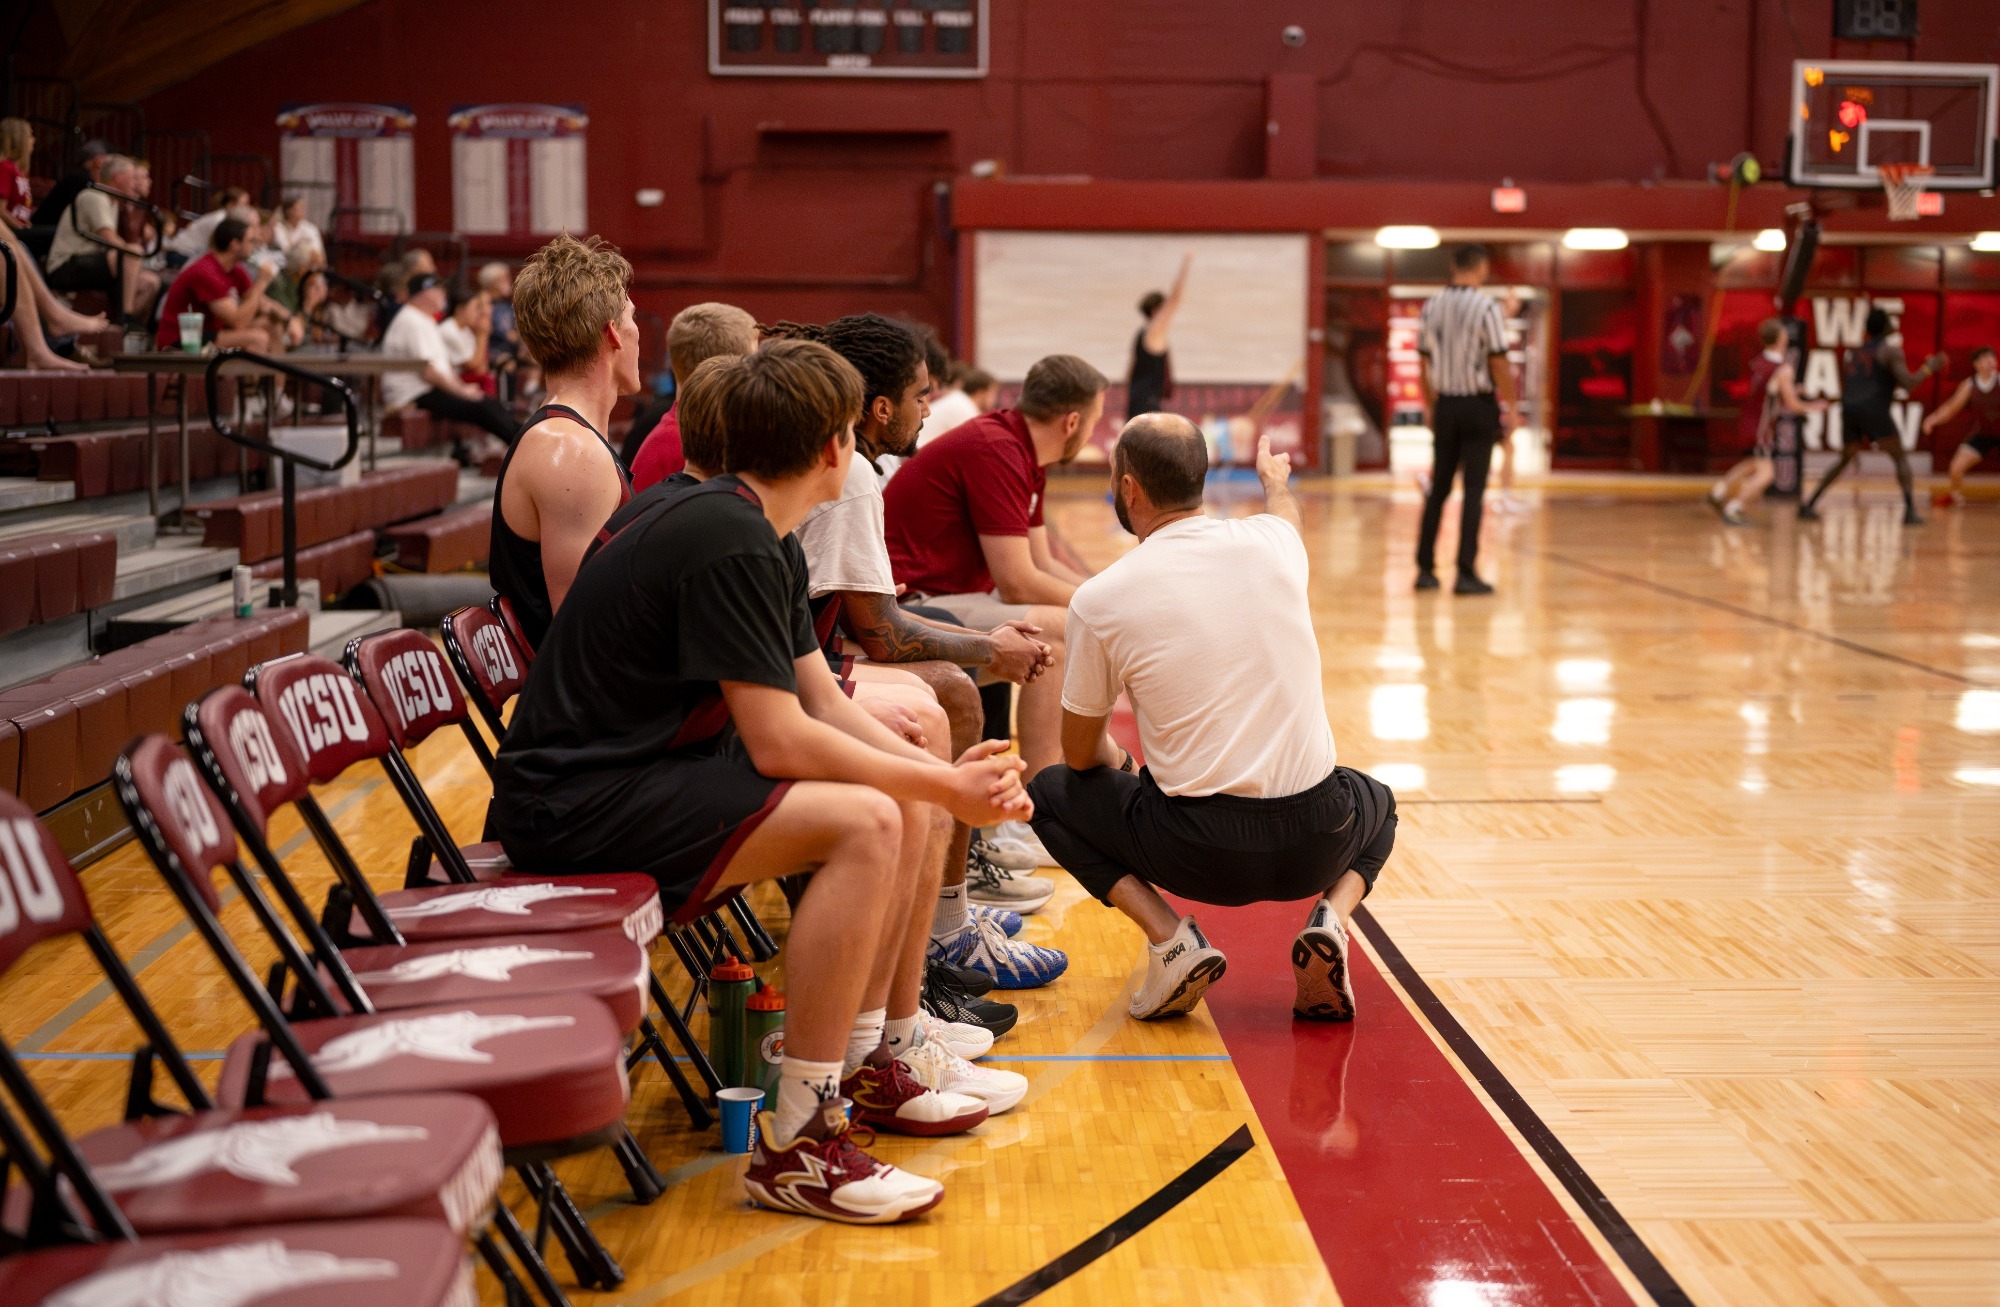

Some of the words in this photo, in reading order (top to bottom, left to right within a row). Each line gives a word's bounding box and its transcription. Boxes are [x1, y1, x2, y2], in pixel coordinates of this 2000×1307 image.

[279, 674, 370, 764] VCSU
[381, 651, 453, 730] VCSU
[1162, 943, 1186, 967] HOKA
